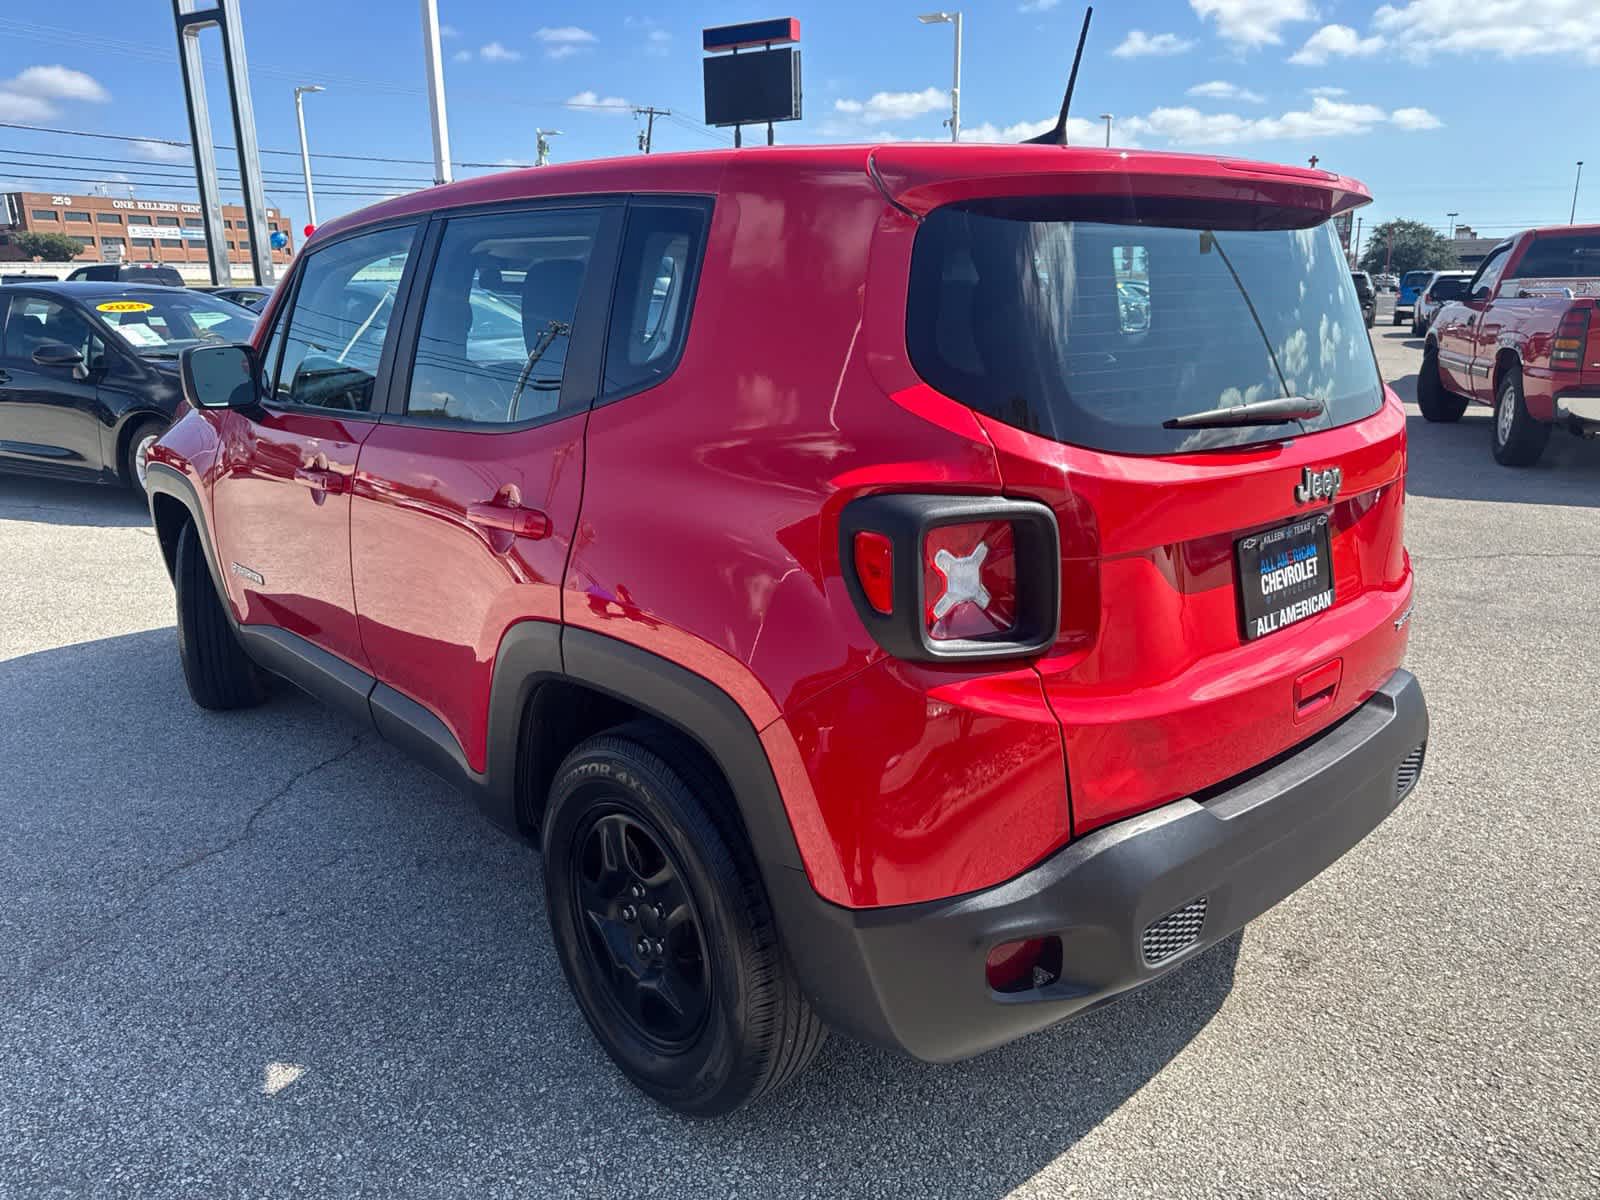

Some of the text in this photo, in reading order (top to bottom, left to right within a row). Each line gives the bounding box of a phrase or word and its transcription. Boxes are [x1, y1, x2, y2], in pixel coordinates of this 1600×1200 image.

[51, 196, 72, 206] 250
[112, 200, 135, 209] ONE
[137, 202, 178, 212] KILLEEN
[104, 303, 146, 311] 2025
[1293, 466, 1341, 505] Jeep
[1262, 522, 1311, 545] KILLEEN TEXAS
[1260, 544, 1317, 575] ALL AMERICAN
[1261, 557, 1318, 595] CHEVROLET
[1256, 590, 1332, 637] ALL AMERICAN
